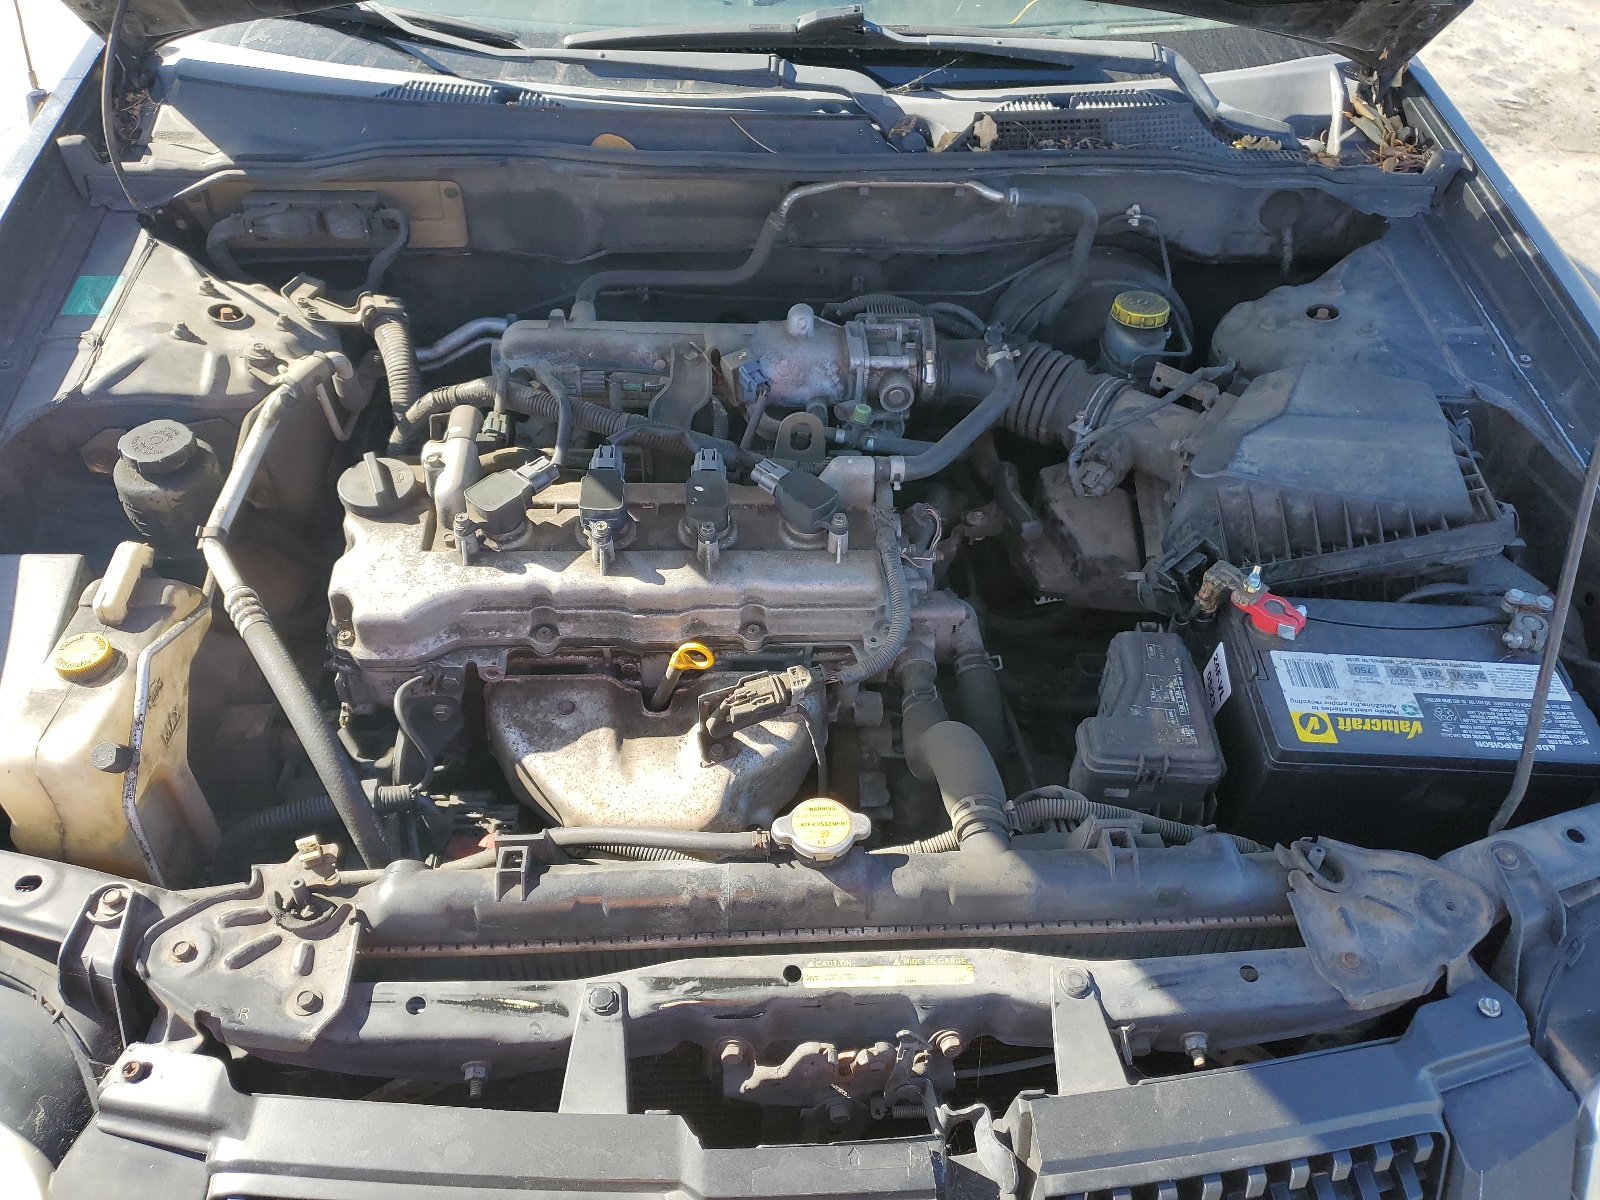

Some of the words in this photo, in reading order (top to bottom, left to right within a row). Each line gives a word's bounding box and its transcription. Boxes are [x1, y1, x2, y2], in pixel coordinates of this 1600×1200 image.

[1354, 666, 1373, 674] 750
[1421, 669, 1441, 678] 24F
[1213, 652, 1225, 703] 24F-VL
[1449, 671, 1486, 680] 24F-VL
[1321, 705, 1354, 713] batteries
[1338, 717, 1424, 739] Valucraft
[1475, 740, 1550, 751] DAER/POISON
[815, 959, 852, 968] CAUTION
[938, 957, 967, 965] GARDE
